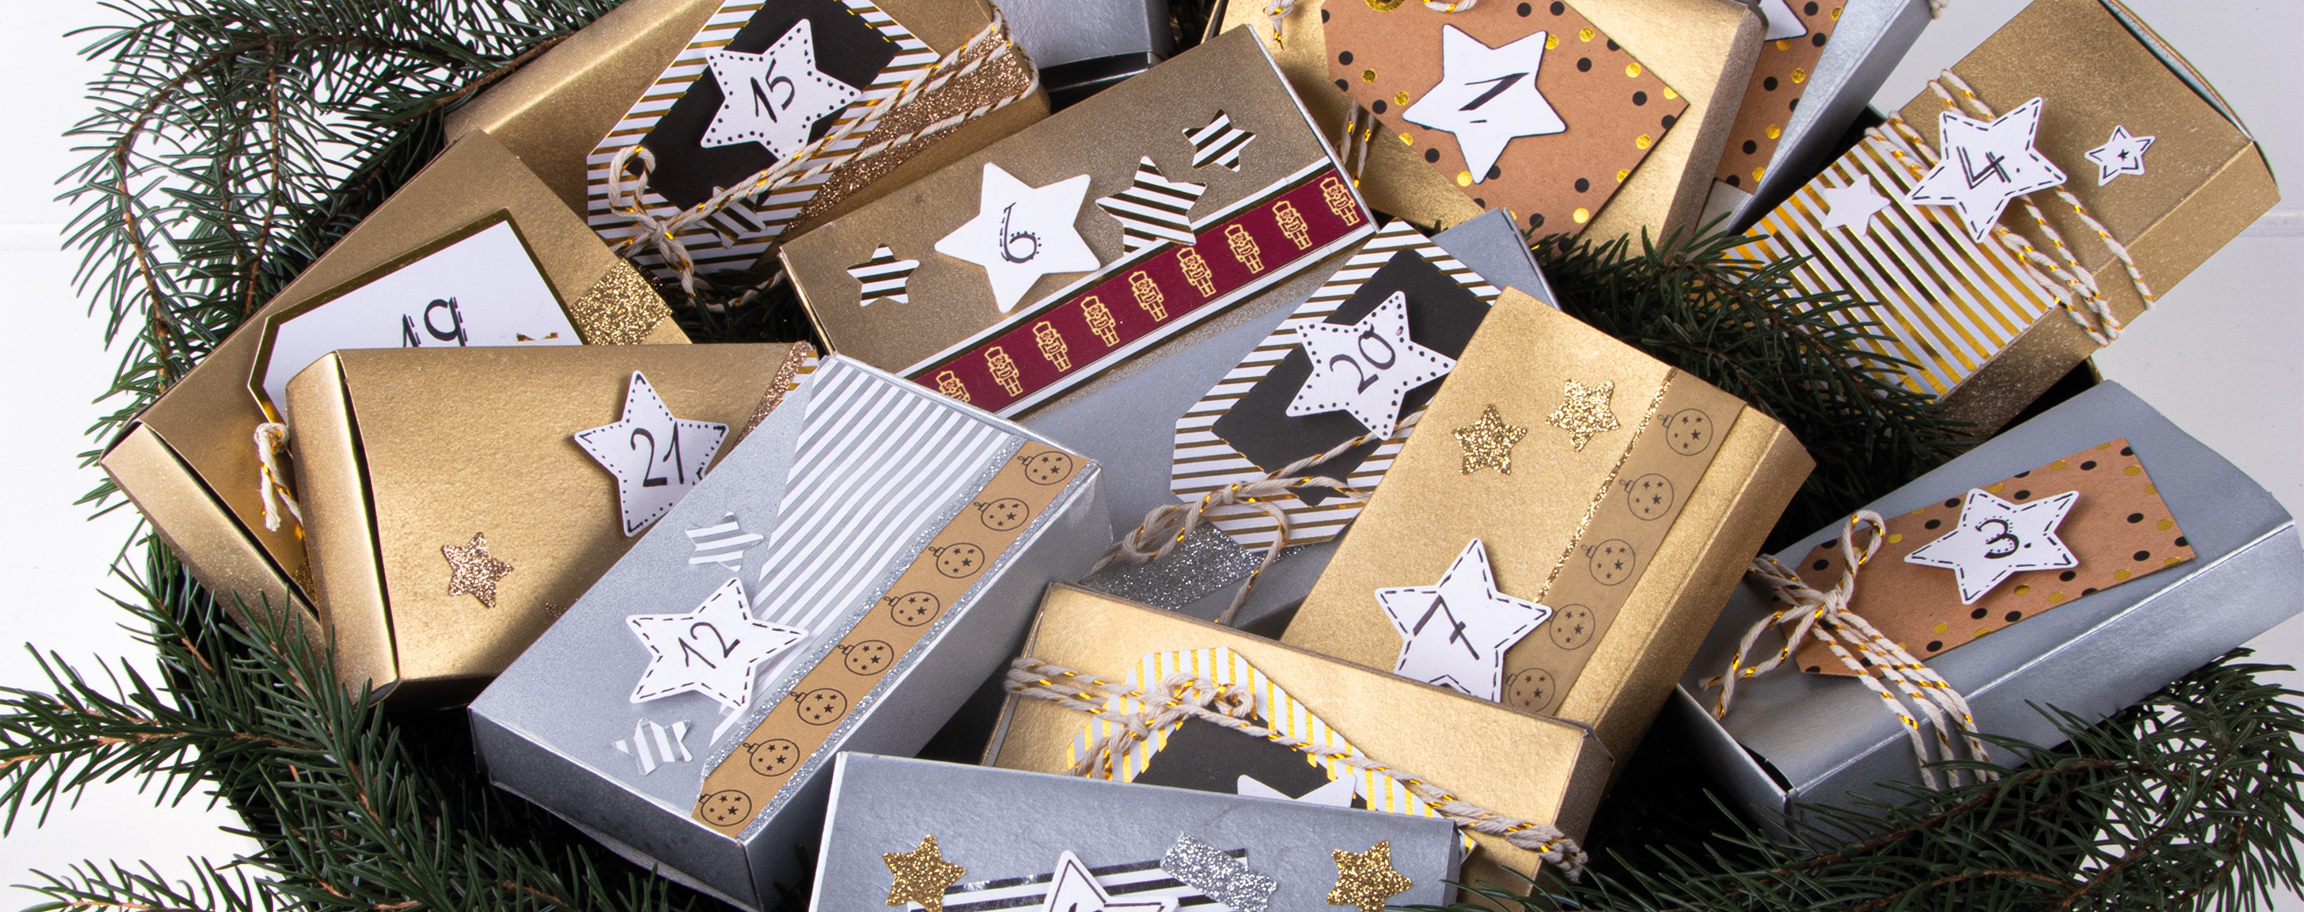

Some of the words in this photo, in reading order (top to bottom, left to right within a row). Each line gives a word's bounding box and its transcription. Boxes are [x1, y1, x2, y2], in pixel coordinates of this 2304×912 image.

[750, 58, 796, 123] 15
[999, 202, 1042, 264] 6
[402, 297, 468, 347] 19
[1329, 323, 1396, 395] 20
[630, 421, 684, 487] 21
[678, 621, 741, 669] 12
[1412, 595, 1480, 661] 7
